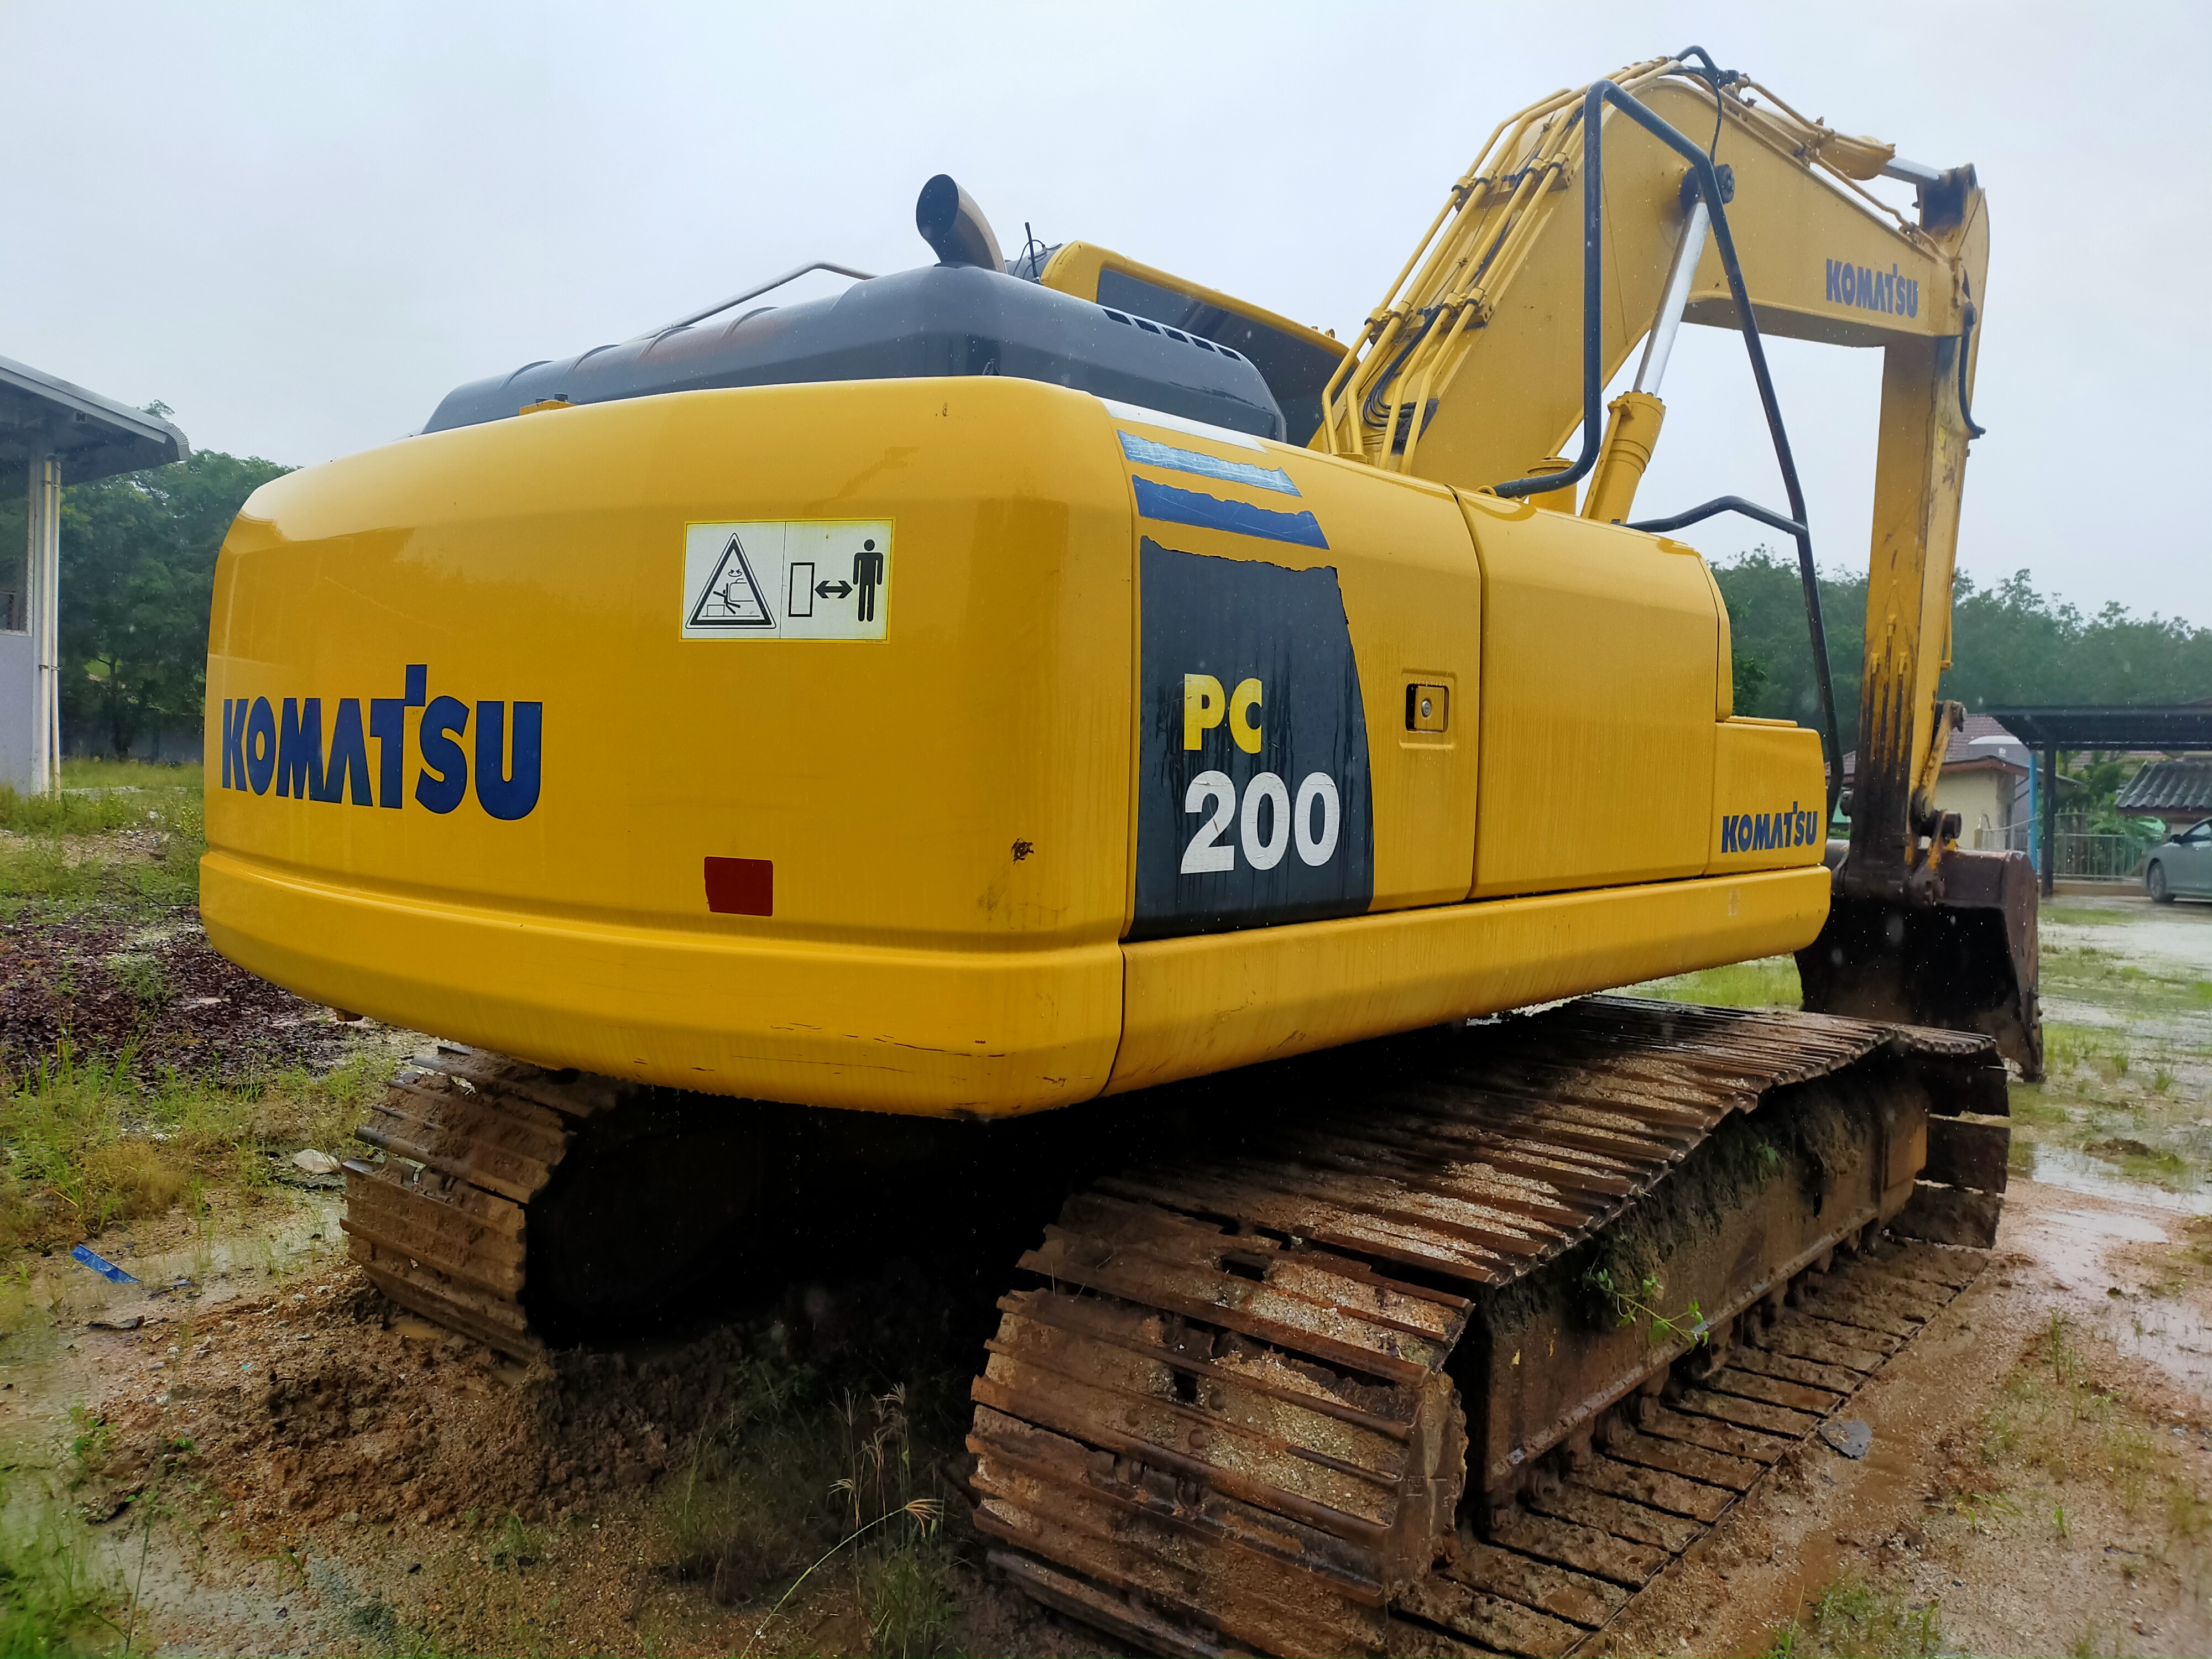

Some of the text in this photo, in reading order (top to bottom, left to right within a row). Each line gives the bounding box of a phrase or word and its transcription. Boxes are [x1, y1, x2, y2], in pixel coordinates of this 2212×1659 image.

[1825, 258, 1918, 319] KOMATSU
[222, 664, 543, 820] KOMATSU
[1183, 673, 1262, 754] PC
[1180, 770, 1340, 874] 200
[1721, 801, 1818, 853] KOMATSU
